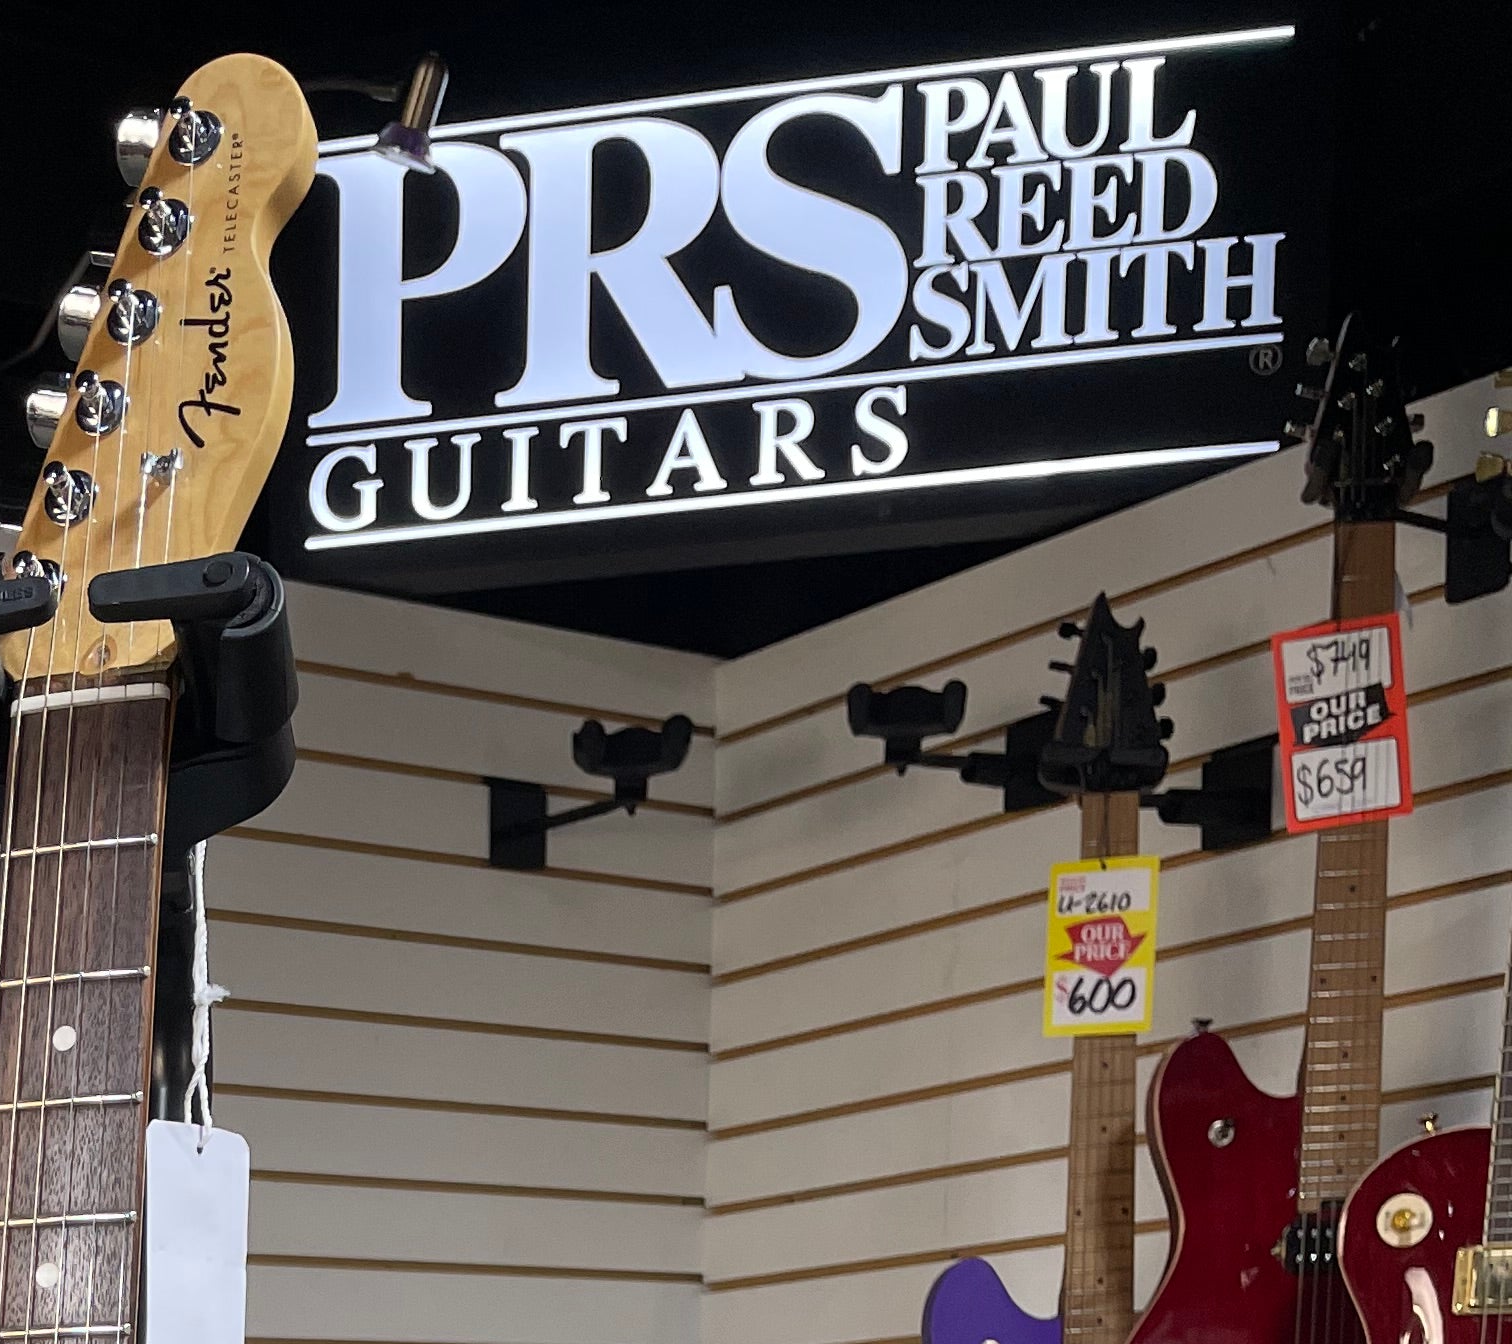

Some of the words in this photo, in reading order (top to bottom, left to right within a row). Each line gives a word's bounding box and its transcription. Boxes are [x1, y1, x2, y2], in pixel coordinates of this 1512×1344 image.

[914, 57, 1197, 175] PAUL
[308, 85, 909, 429] PRS
[913, 149, 1218, 268] REED
[909, 232, 1286, 362] SMITH
[178, 267, 242, 449] Fender
[308, 385, 909, 534] GUITARS
[1302, 702, 1383, 744] PRICE
[1309, 690, 1368, 722] OUR
[1296, 756, 1368, 809] $659
[1073, 941, 1131, 963] PRICE
[1079, 922, 1126, 944] OUR
